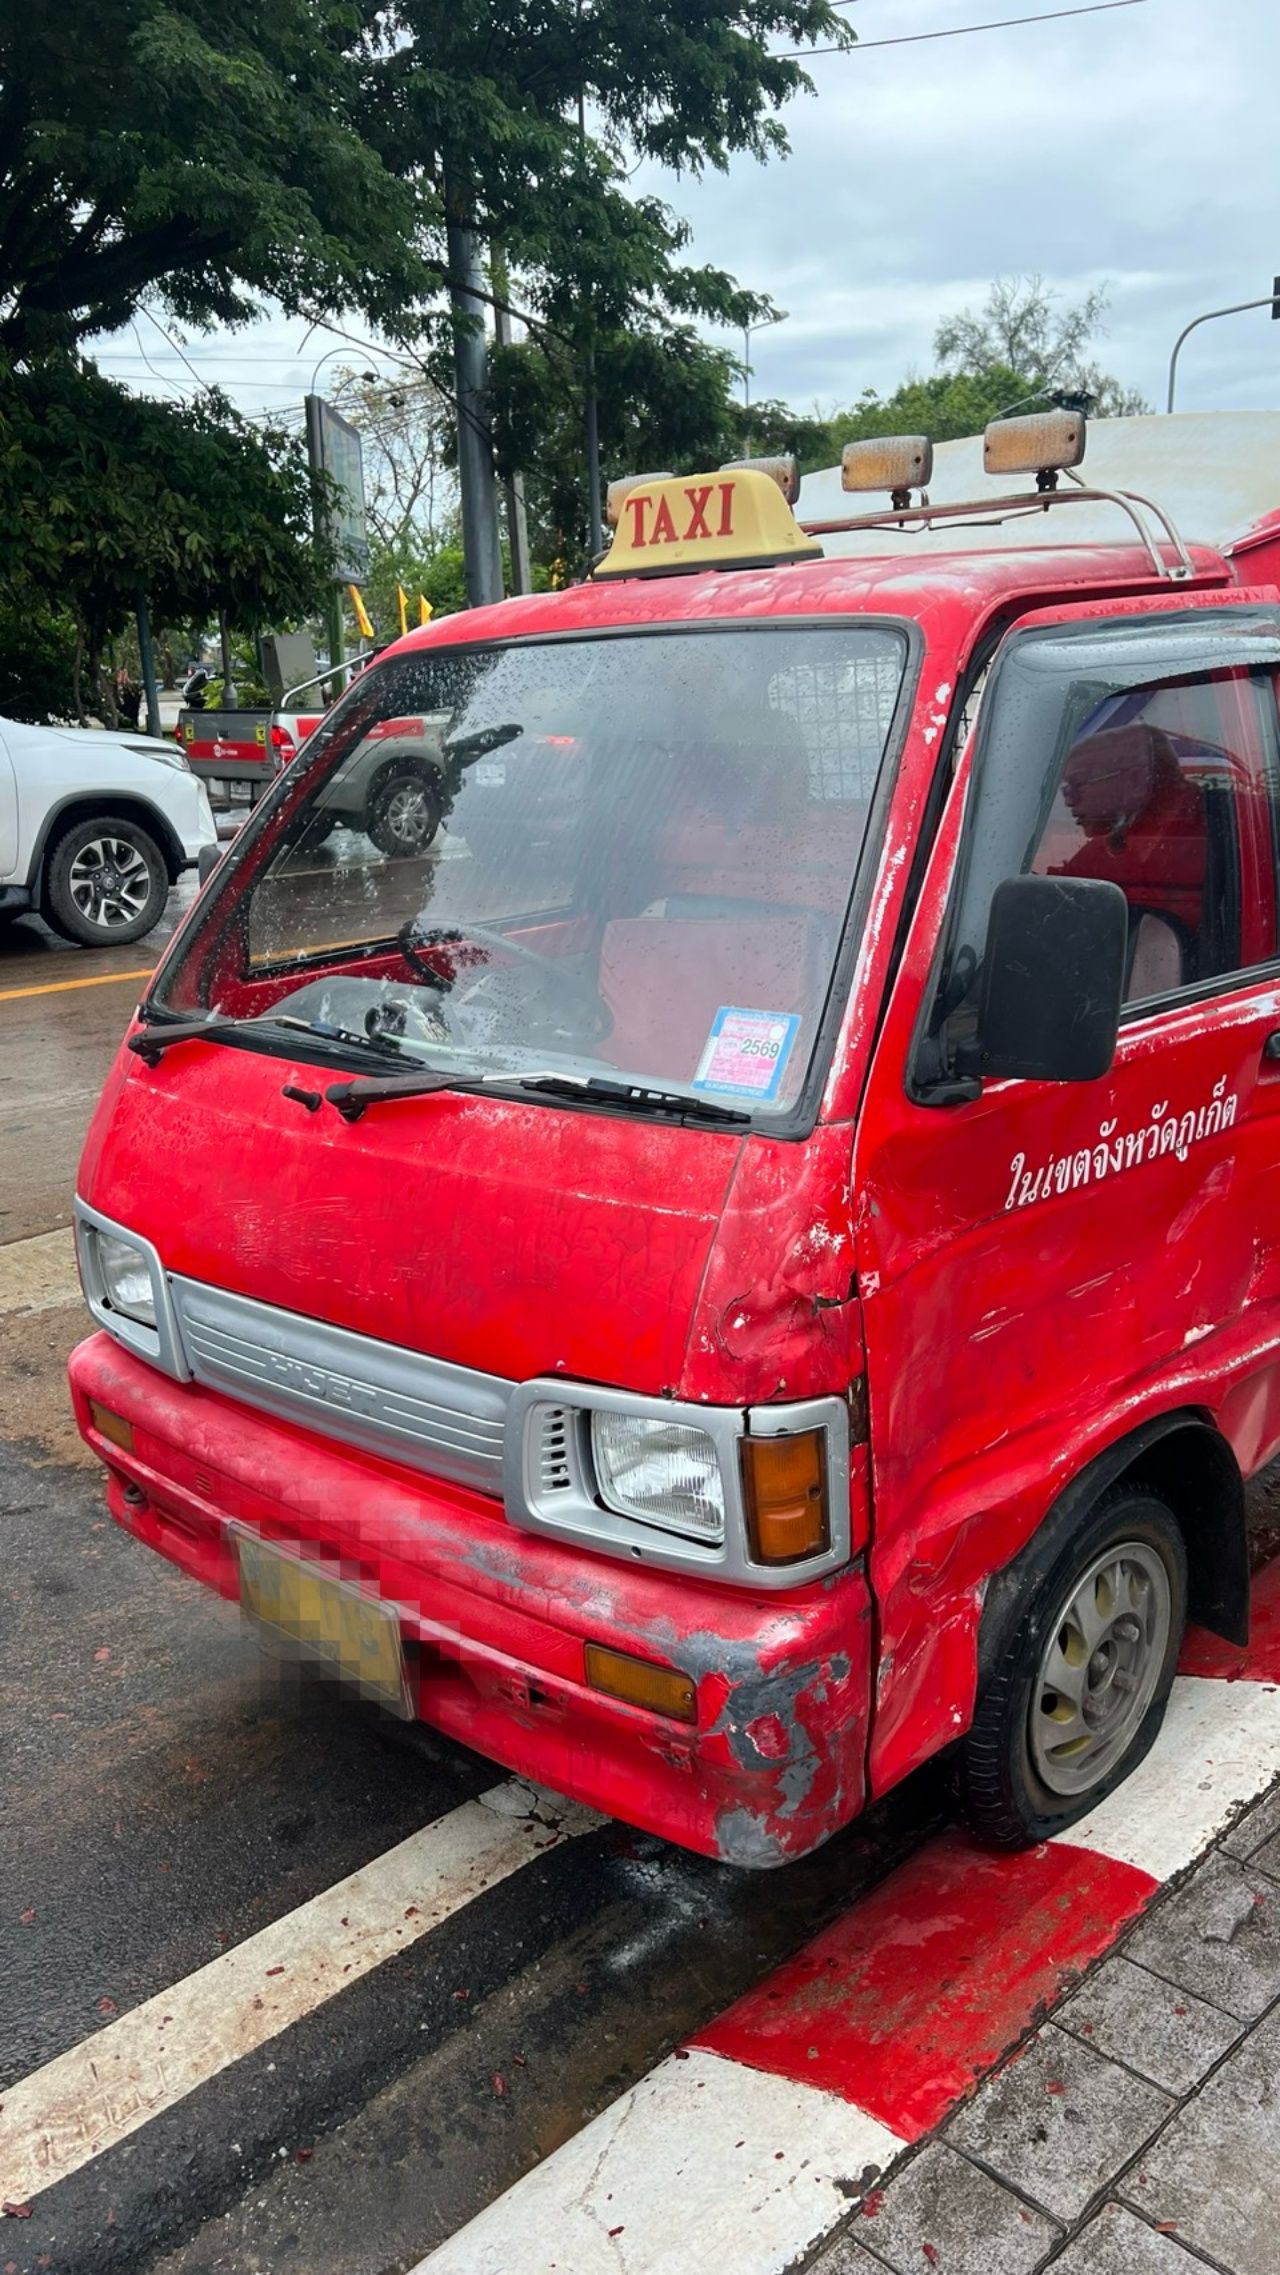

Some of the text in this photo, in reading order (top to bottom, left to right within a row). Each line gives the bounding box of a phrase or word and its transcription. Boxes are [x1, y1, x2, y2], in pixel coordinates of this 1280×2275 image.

[625, 483, 736, 548] TAXI
[741, 1038, 780, 1059] 2569
[1004, 1074, 1238, 1210] ในเขตจังหวัดภูเก็ต
